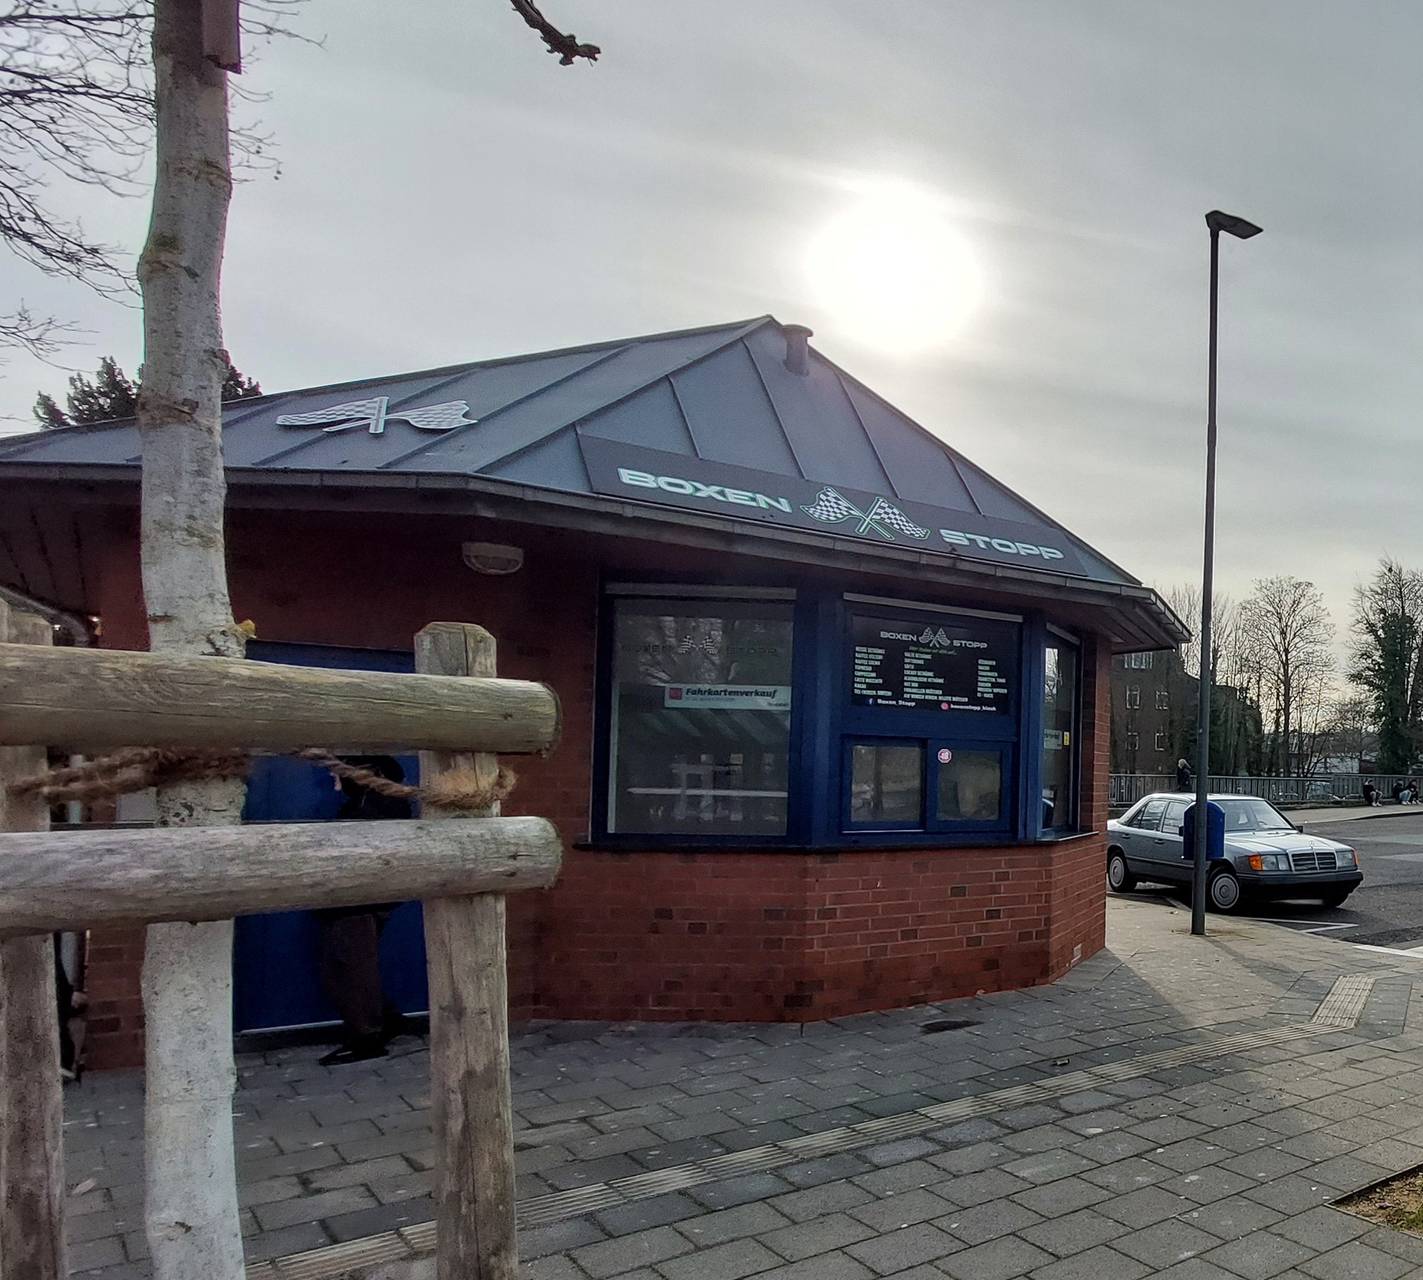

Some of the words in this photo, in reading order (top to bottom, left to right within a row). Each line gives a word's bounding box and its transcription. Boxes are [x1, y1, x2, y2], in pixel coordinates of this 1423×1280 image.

[617, 467, 793, 513] BOXEN
[938, 528, 1065, 560] STOPP
[880, 631, 917, 642] BOXEN
[952, 639, 988, 649] STOPP
[685, 687, 778, 699] Fahrkartenverkauf
